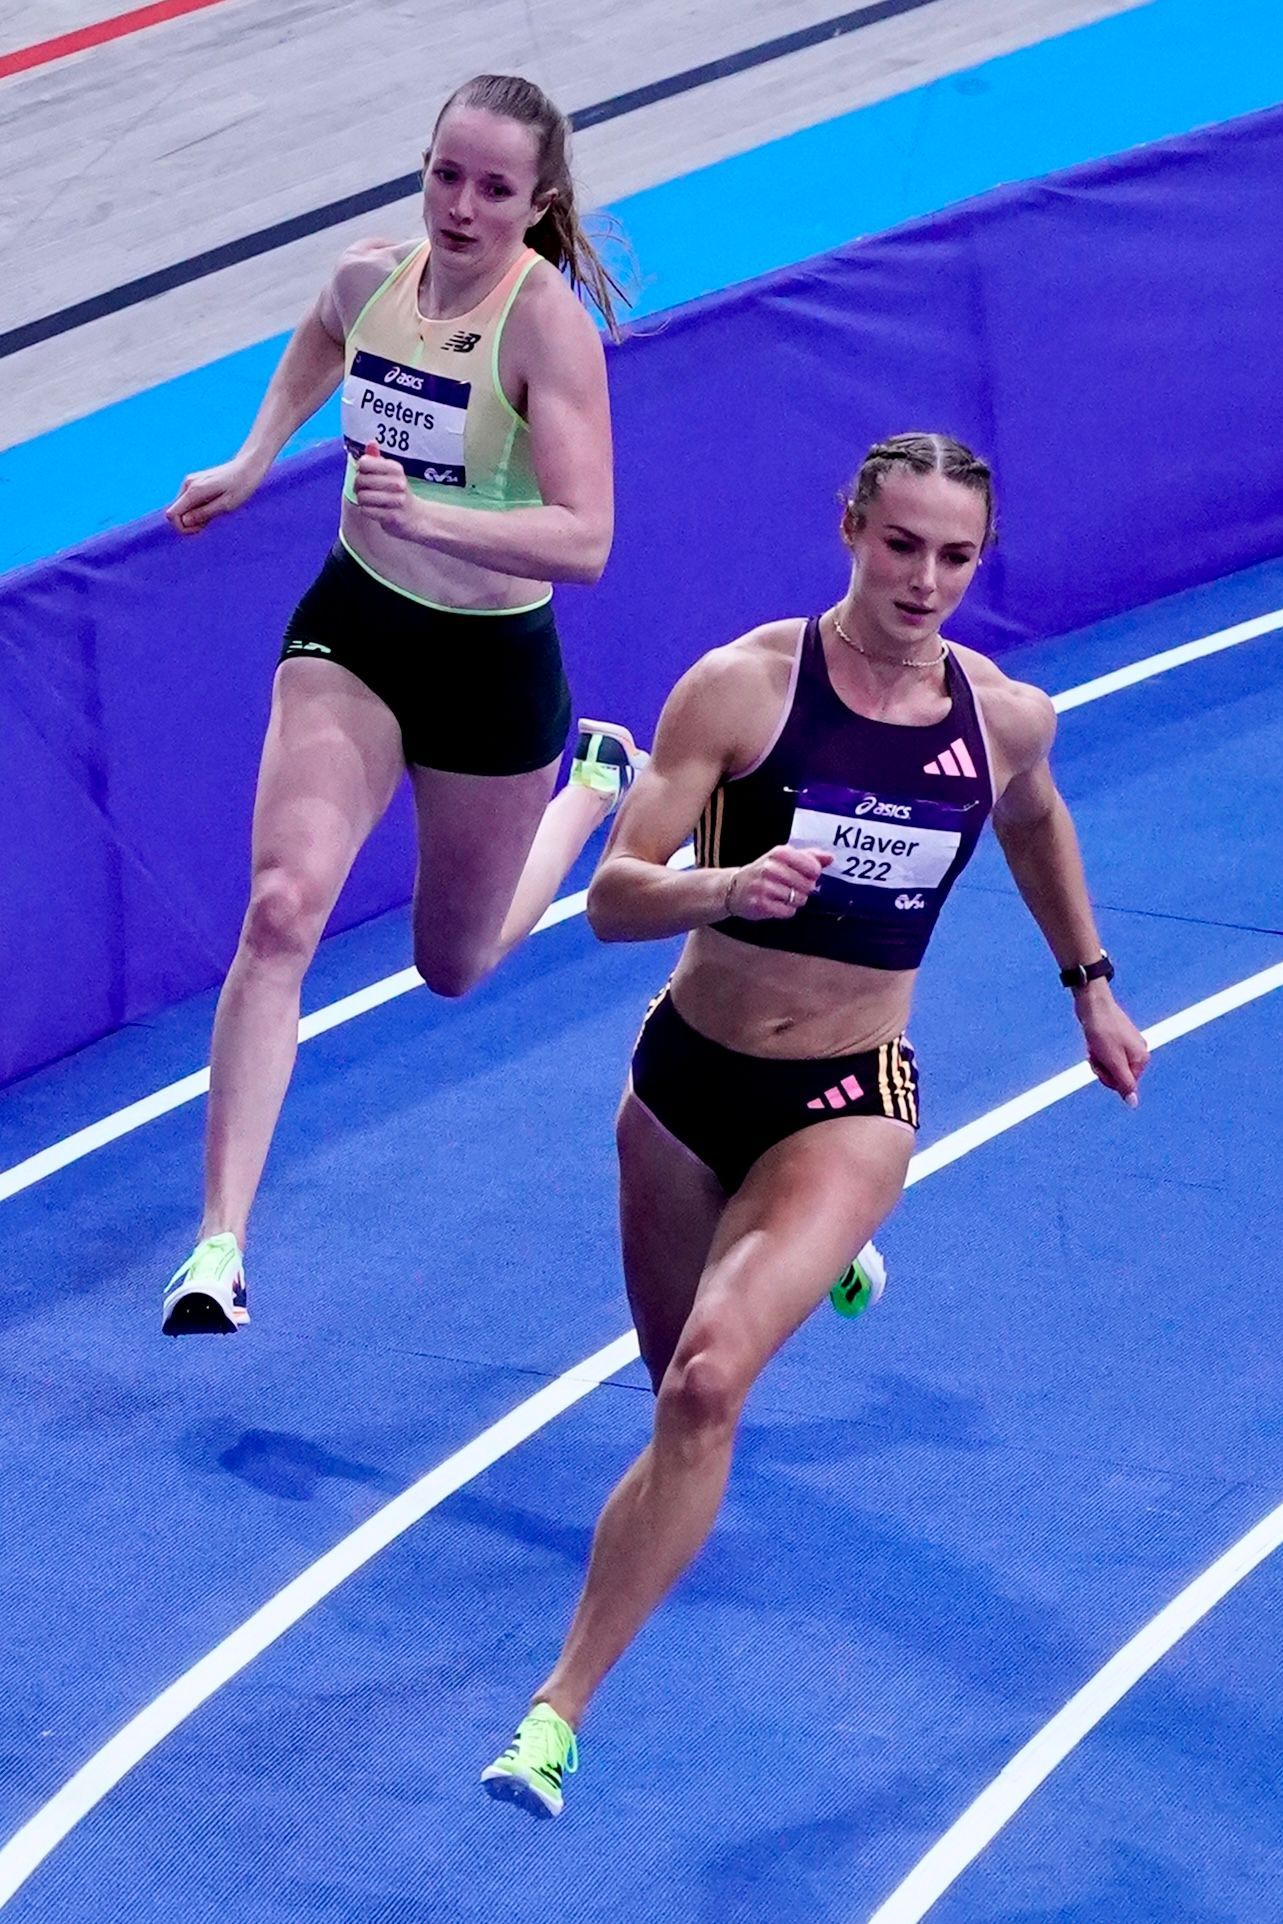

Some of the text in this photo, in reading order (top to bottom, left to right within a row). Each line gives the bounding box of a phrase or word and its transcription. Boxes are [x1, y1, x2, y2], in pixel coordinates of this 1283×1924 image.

[360, 388, 435, 430] Peeters
[375, 423, 410, 452] 338
[832, 824, 920, 857] Klaver
[841, 856, 892, 882] 222
